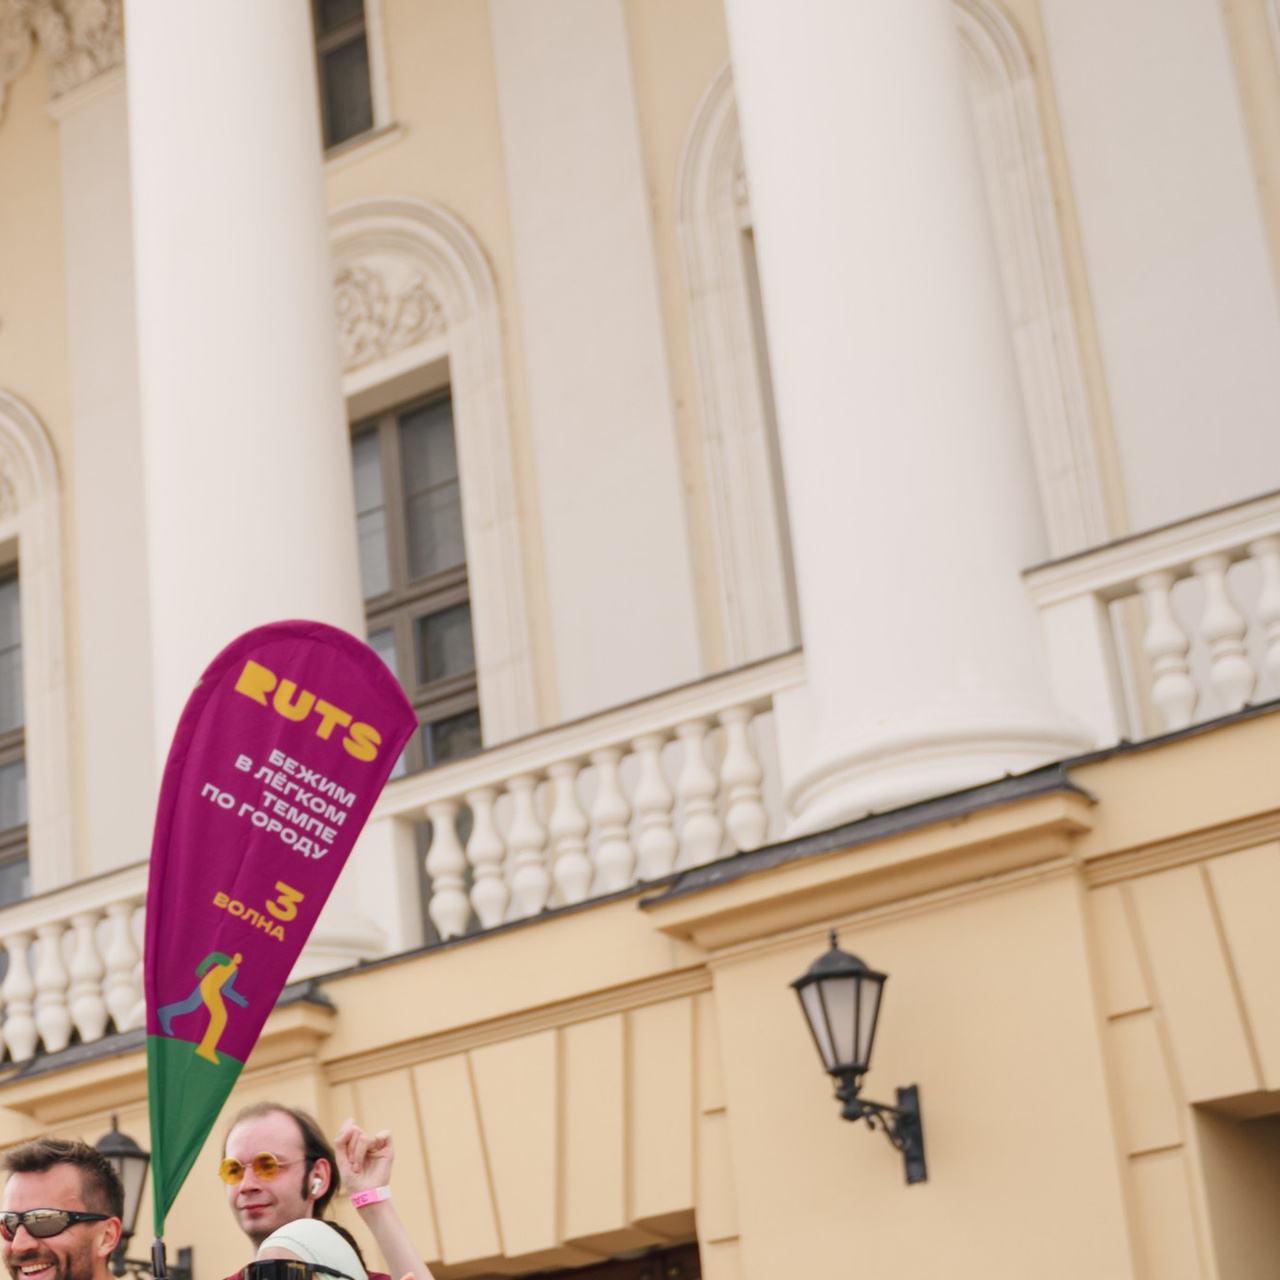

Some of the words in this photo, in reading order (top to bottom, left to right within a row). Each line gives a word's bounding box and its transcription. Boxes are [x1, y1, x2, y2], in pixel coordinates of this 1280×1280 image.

[234, 660, 383, 763] RUTS
[234, 754, 253, 773] В
[253, 770, 347, 827] ЛЁГКОМ
[268, 748, 357, 809] БЕЖИМ
[200, 782, 236, 811] ПО
[237, 801, 329, 861] ГОРОДУ
[262, 790, 338, 844] ТЕМПЕ
[212, 891, 285, 942] ВОЛНА
[265, 880, 306, 922] 3
